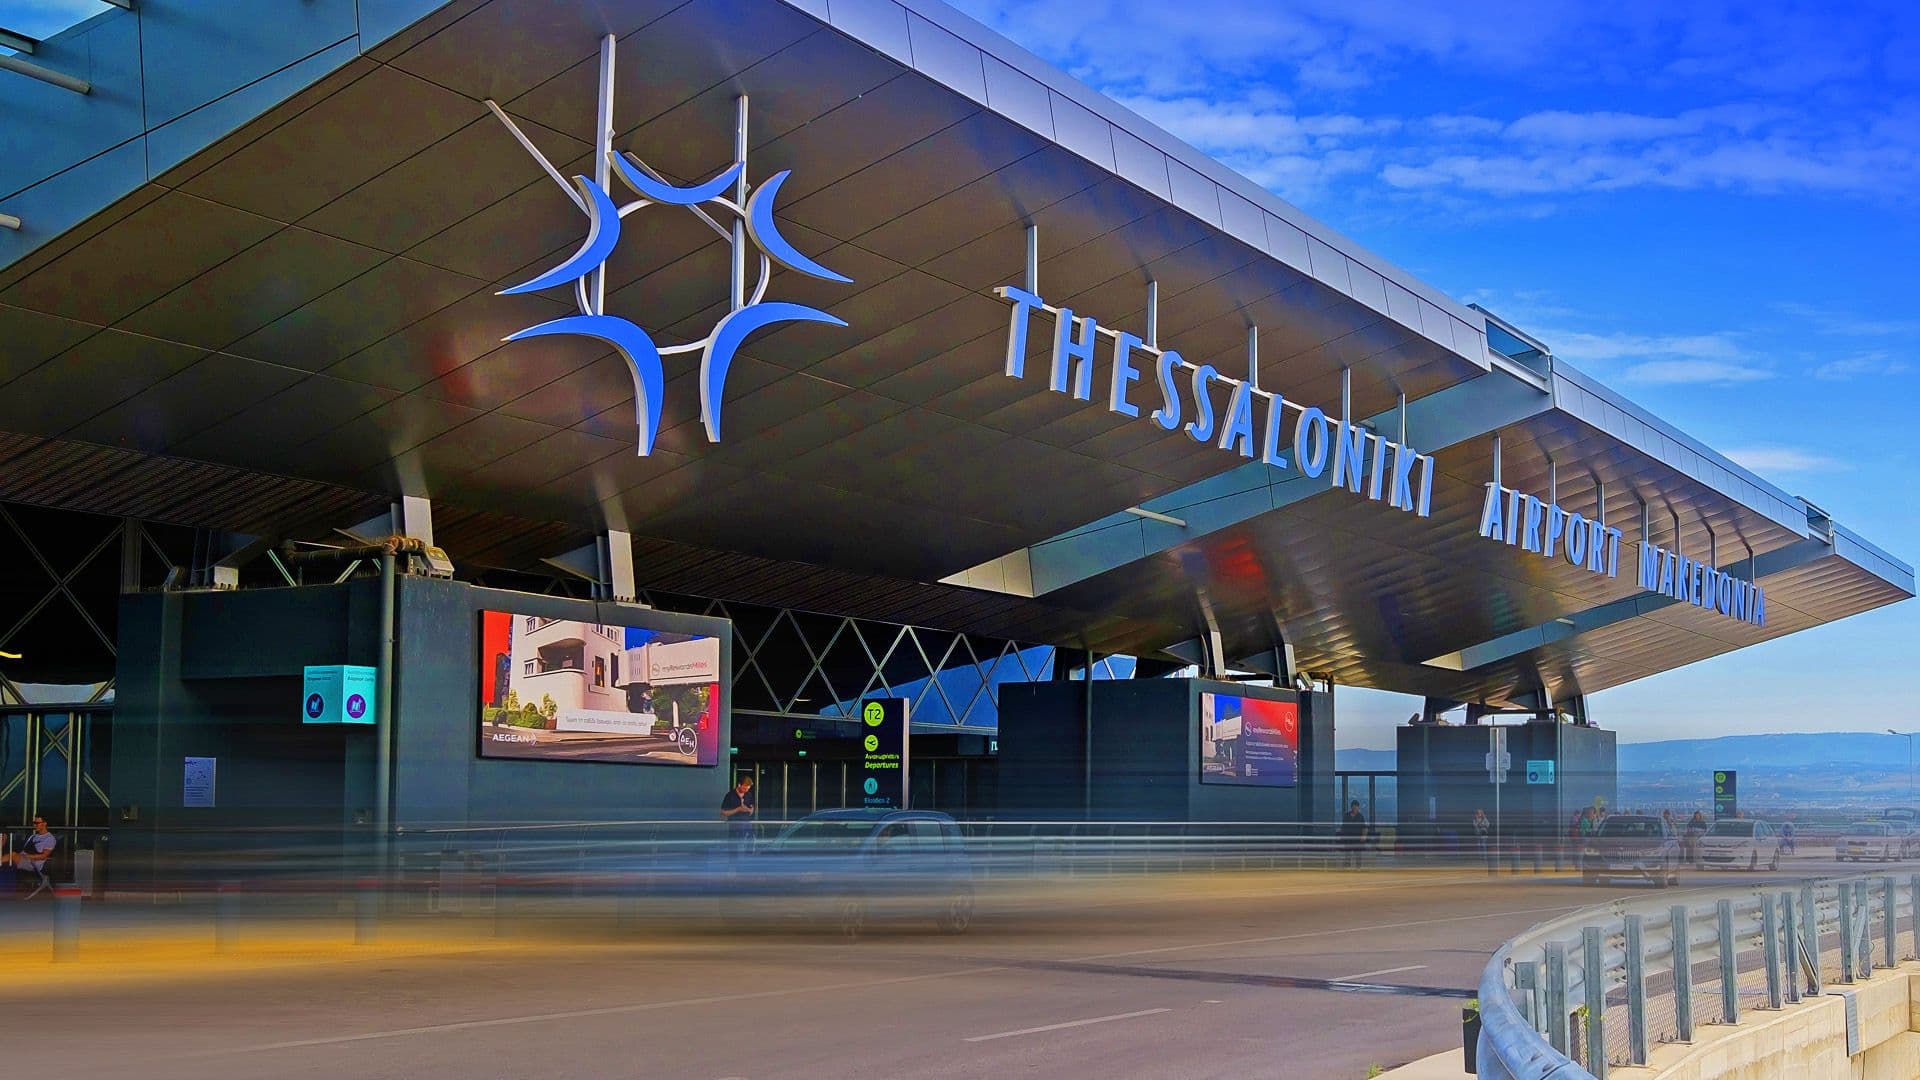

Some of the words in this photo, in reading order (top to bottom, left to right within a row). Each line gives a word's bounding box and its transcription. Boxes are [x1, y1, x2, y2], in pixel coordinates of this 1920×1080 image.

[995, 285, 1434, 517] THESSALONIKI
[1480, 483, 1623, 578] AIRPORT
[1637, 540, 1766, 628] MAKEDONIA
[867, 708, 880, 720] T2
[492, 733, 530, 743] AEGEAN
[864, 761, 898, 770] Departures
